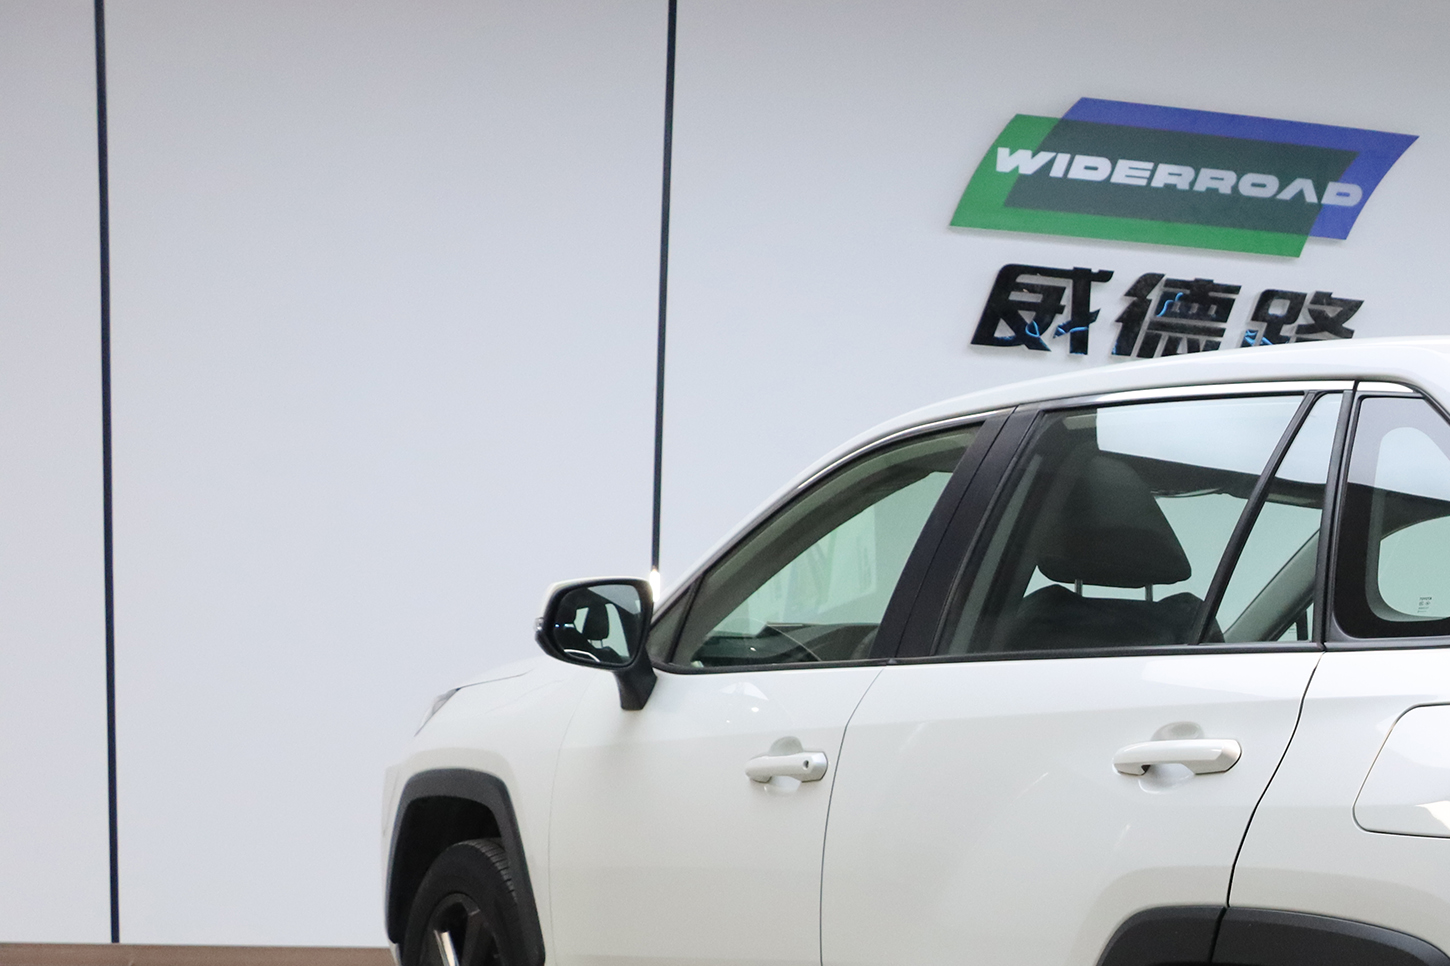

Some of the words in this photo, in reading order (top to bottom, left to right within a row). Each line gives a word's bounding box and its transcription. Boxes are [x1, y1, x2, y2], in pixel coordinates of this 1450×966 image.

[996, 147, 1364, 207] WIDERROAD
[970, 263, 1365, 358] 威德路
